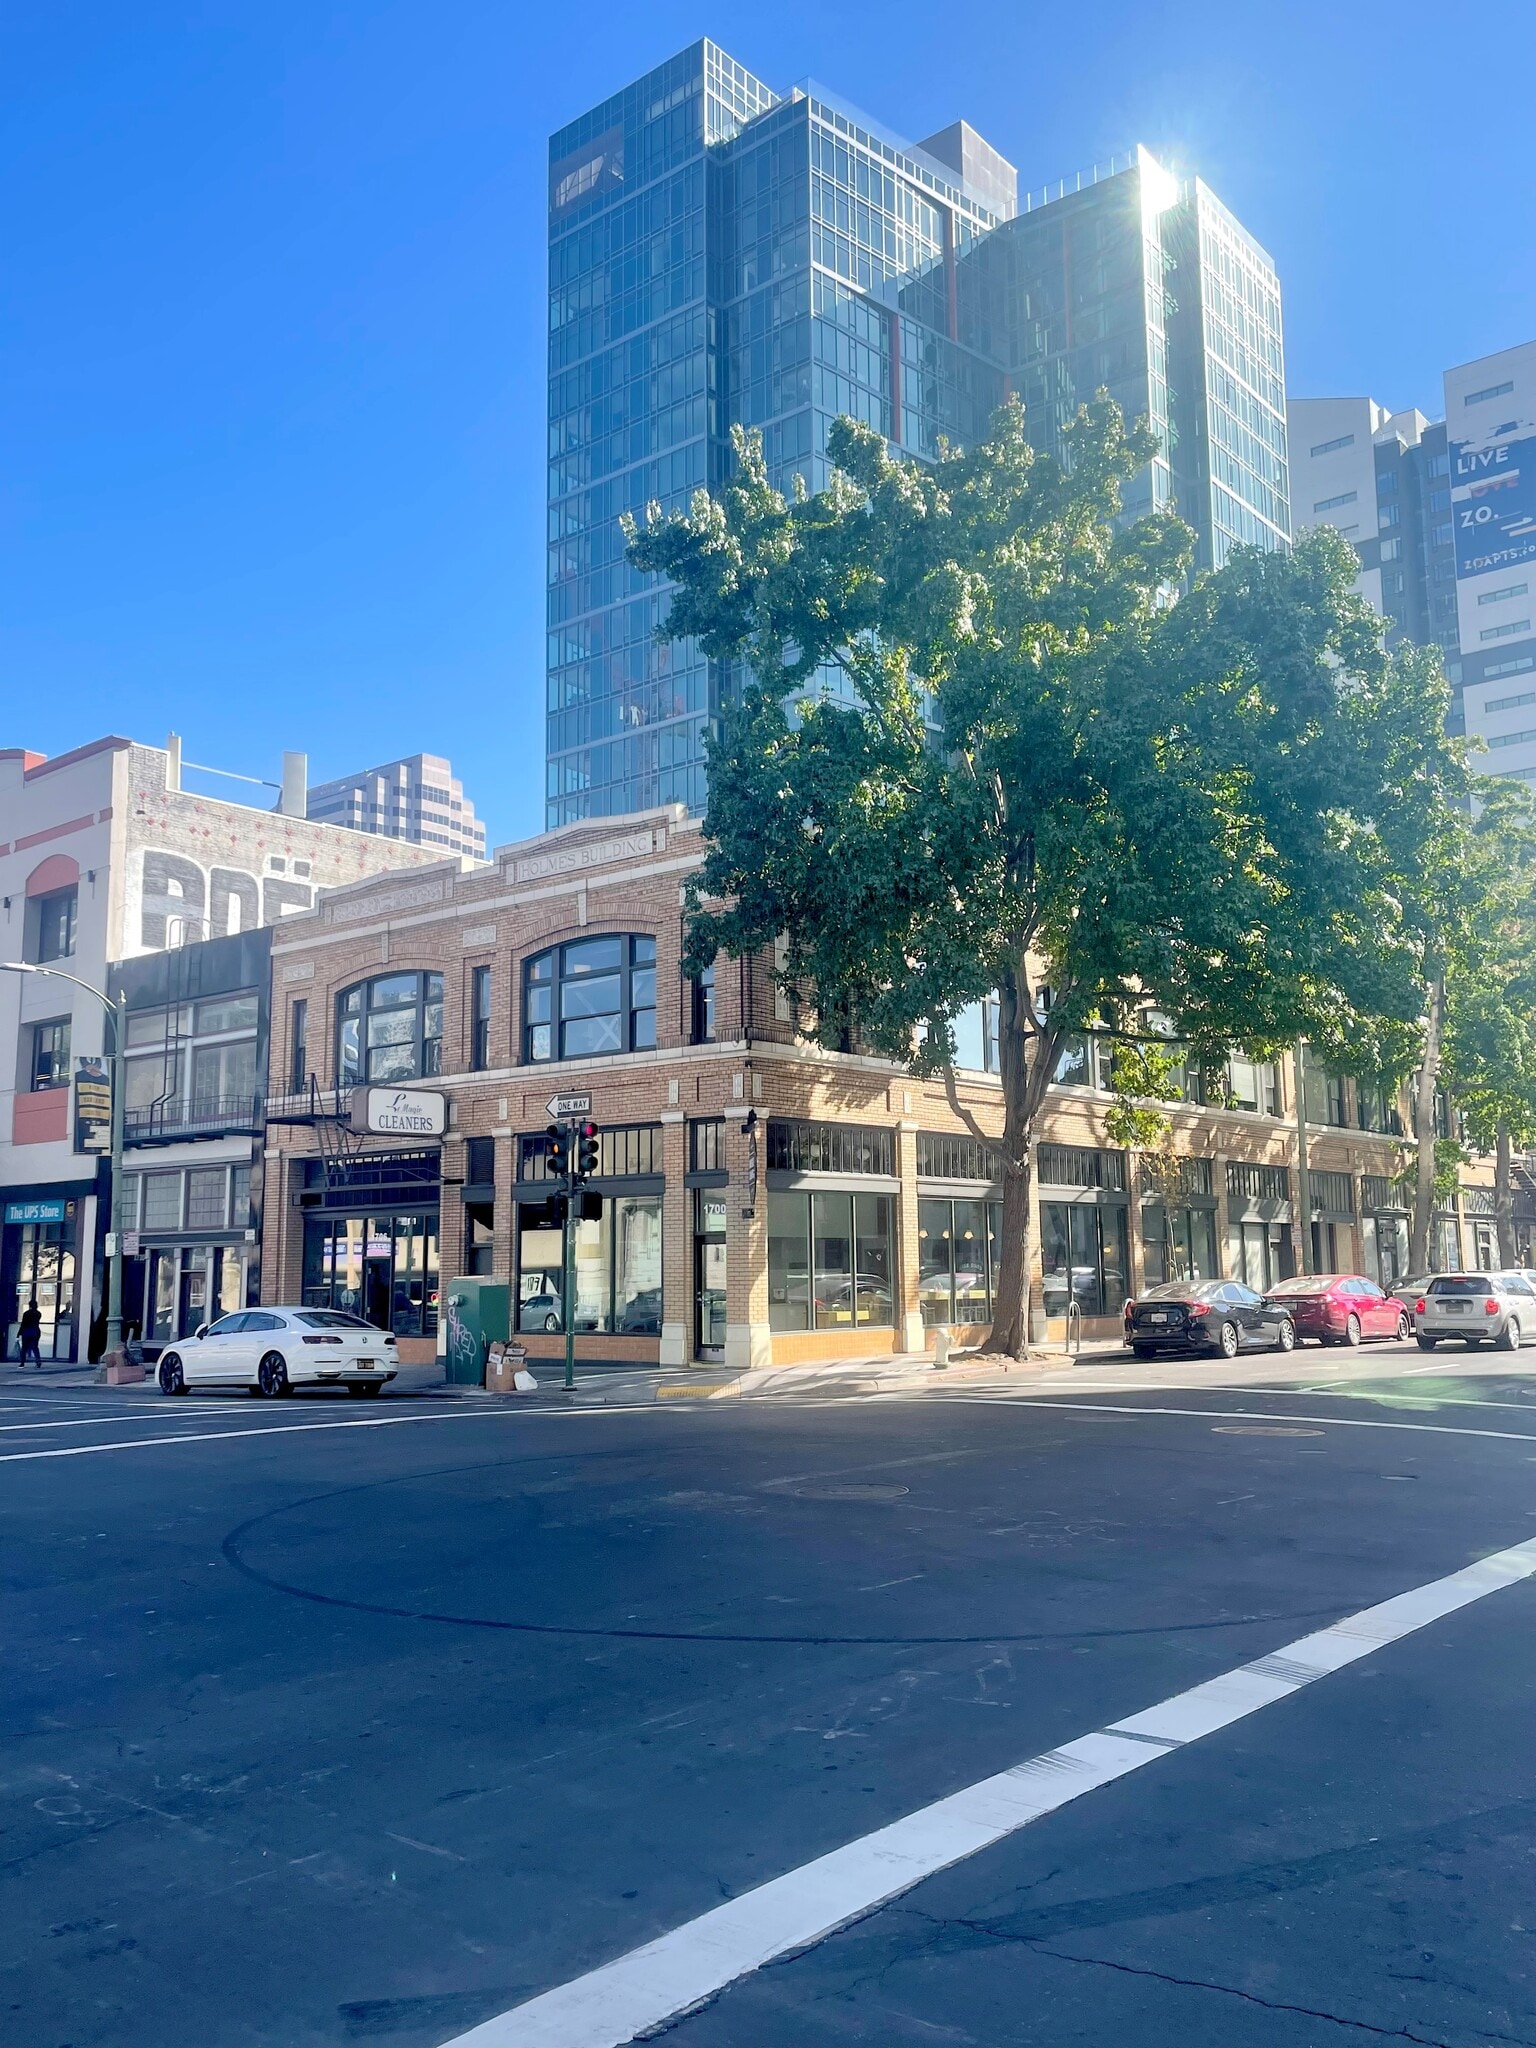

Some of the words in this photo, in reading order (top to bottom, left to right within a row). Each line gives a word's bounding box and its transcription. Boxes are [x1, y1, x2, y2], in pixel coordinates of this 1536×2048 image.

[1457, 446, 1509, 475] LIVE
[1460, 506, 1499, 528] ZO.
[521, 854, 576, 878] HOLMES
[581, 837, 647, 864] BUILDING
[558, 1101, 571, 1111] ONE
[573, 1100, 587, 1109] WAY
[378, 1115, 433, 1131] CLEANERS
[10, 1206, 23, 1220] The
[24, 1205, 39, 1218] UPS
[40, 1205, 60, 1218] Store
[703, 1204, 726, 1214] 1700
